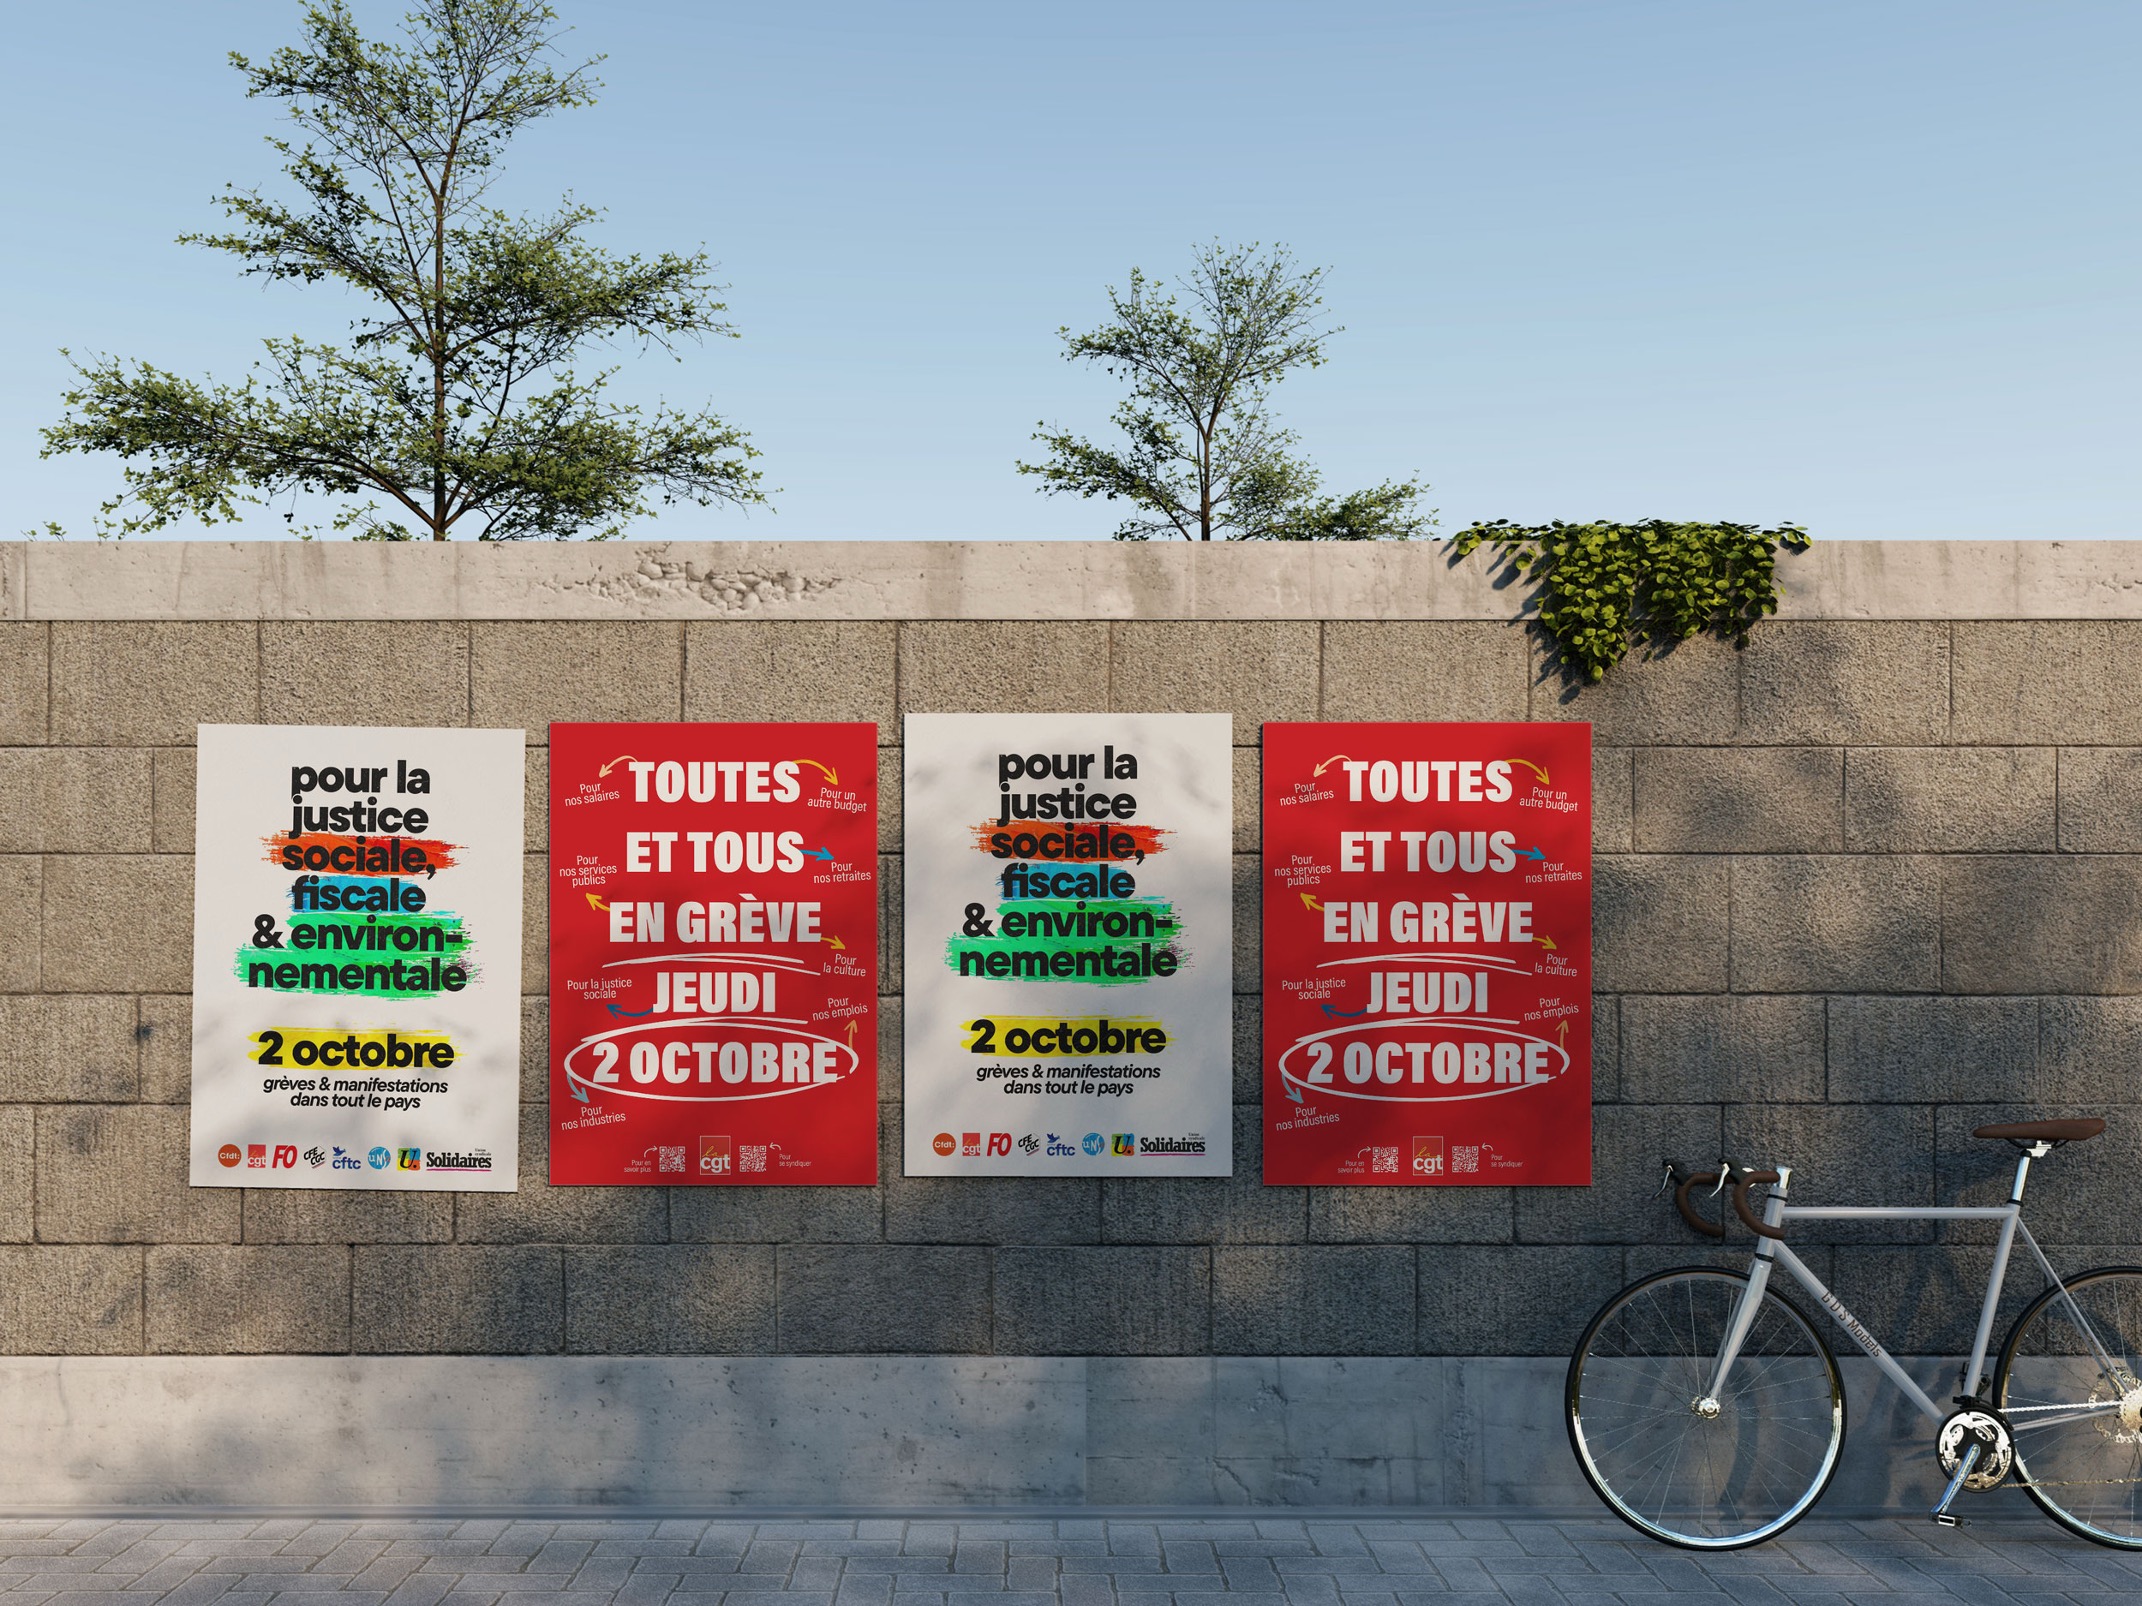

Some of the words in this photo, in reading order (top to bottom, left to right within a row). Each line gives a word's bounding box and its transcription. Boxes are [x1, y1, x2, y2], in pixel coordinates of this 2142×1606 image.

[999, 753, 1095, 786] pour
[1104, 745, 1137, 779] la
[291, 766, 388, 799] pour
[397, 760, 430, 794] la
[629, 760, 800, 803] TOUTES
[1343, 760, 1513, 803] TOUTES
[580, 783, 601, 794] Pour
[820, 787, 842, 799] Pour
[844, 792, 856, 800] un
[1294, 782, 1316, 794] Pour
[1532, 786, 1554, 799] Pour
[1556, 791, 1567, 800] un
[565, 796, 582, 806] nos
[584, 790, 620, 804] salaires
[807, 798, 831, 808] autre
[834, 801, 867, 814] budget
[997, 783, 1137, 827] justice
[1280, 796, 1297, 806] nos
[1299, 790, 1334, 804] salaires
[1519, 798, 1543, 808] autre
[1546, 799, 1579, 813] budget
[288, 794, 429, 839] justice
[991, 822, 1145, 865] sociale,
[1341, 832, 1392, 872] ET
[1400, 830, 1517, 873] TOUS
[282, 836, 436, 880] sociale,
[577, 855, 598, 865] Pour
[627, 832, 678, 873] ET
[687, 831, 804, 873] TOUS
[1291, 855, 1313, 865] Pour
[560, 868, 576, 877] nos
[579, 864, 617, 876] services
[831, 862, 852, 872] Pour
[1274, 867, 1291, 877] nos
[1293, 864, 1332, 876] services
[1543, 862, 1564, 872] Pour
[572, 875, 606, 888] publics
[814, 874, 830, 884] nos
[833, 871, 872, 882] retraites
[1001, 863, 1135, 898] fiscale
[1287, 875, 1320, 888] publics
[1525, 874, 1542, 884] nos
[1545, 870, 1583, 882] retraites
[292, 875, 426, 912] fiscale
[609, 902, 665, 943] EN
[676, 893, 822, 943] GRÈVE
[962, 902, 995, 937] &
[1001, 901, 1172, 937] environ-
[1324, 902, 1379, 943] EN
[1390, 893, 1533, 943] GRÈVE
[252, 914, 283, 949] &
[291, 915, 463, 951] environ-
[835, 953, 857, 966] Pour
[960, 943, 1177, 977] nementale
[1546, 953, 1568, 966] Pour
[249, 957, 468, 992] nementale
[823, 962, 832, 973] la
[834, 964, 866, 977] culture
[1534, 962, 1543, 973] la
[1545, 964, 1578, 977] culture
[567, 980, 588, 991] Pour
[591, 978, 599, 990] la
[600, 977, 632, 992] justice
[1282, 980, 1303, 991] Pour
[1305, 978, 1314, 990] la
[1315, 977, 1346, 992] justice
[584, 988, 616, 1000] sociale
[652, 972, 776, 1014] JEUDI
[1298, 988, 1331, 1000] sociale
[1366, 972, 1488, 1014] JEUDI
[828, 997, 849, 1008] Pour
[1539, 997, 1561, 1008] Pour
[812, 1011, 829, 1021] nos
[831, 1003, 868, 1019] emplois
[1524, 1012, 1541, 1022] nos
[1543, 1003, 1579, 1019] emplois
[971, 1019, 996, 1053] 2
[1005, 1020, 1166, 1054] octobre
[258, 1031, 283, 1065] 2
[292, 1034, 455, 1068] octobre
[592, 1041, 619, 1083] 2
[629, 1041, 837, 1084] OCTOBRE
[1307, 1042, 1334, 1083] 2
[1343, 1041, 1549, 1084] OCTOBRE
[976, 1064, 1029, 1081] grèves
[1032, 1064, 1043, 1078] &
[1046, 1064, 1161, 1078] manifestations
[263, 1075, 316, 1093] grèves
[319, 1077, 330, 1091] &
[333, 1077, 449, 1093] manifestations
[1004, 1080, 1042, 1094] dans
[1045, 1082, 1078, 1094] tout
[1080, 1080, 1094, 1094] le
[1097, 1083, 1134, 1097] pays
[290, 1092, 328, 1107] dans
[332, 1094, 365, 1107] tout
[367, 1094, 381, 1108] le
[384, 1097, 421, 1111] pays
[581, 1106, 602, 1117] Pour
[1295, 1106, 1317, 1117] Pour
[561, 1120, 578, 1131] nos
[580, 1112, 626, 1127] industries
[1276, 1121, 1293, 1131] nos
[1294, 1113, 1340, 1127] industries
[987, 1133, 1012, 1157] FO
[1018, 1133, 1032, 1148] CFE
[1025, 1139, 1039, 1153] CGC
[1140, 1137, 1205, 1152] Solidaires
[272, 1145, 298, 1169] FO
[303, 1146, 318, 1161] CFE
[963, 1144, 980, 1155] cgt
[1047, 1144, 1075, 1156] cftc
[248, 1156, 266, 1168] cgt
[310, 1151, 325, 1166] CGC
[332, 1157, 361, 1169] cftc
[426, 1152, 492, 1168] Solidaires
[700, 1154, 731, 1173] cgt
[1413, 1154, 1443, 1174] cgt
[1847, 1319, 1882, 1357] Models
